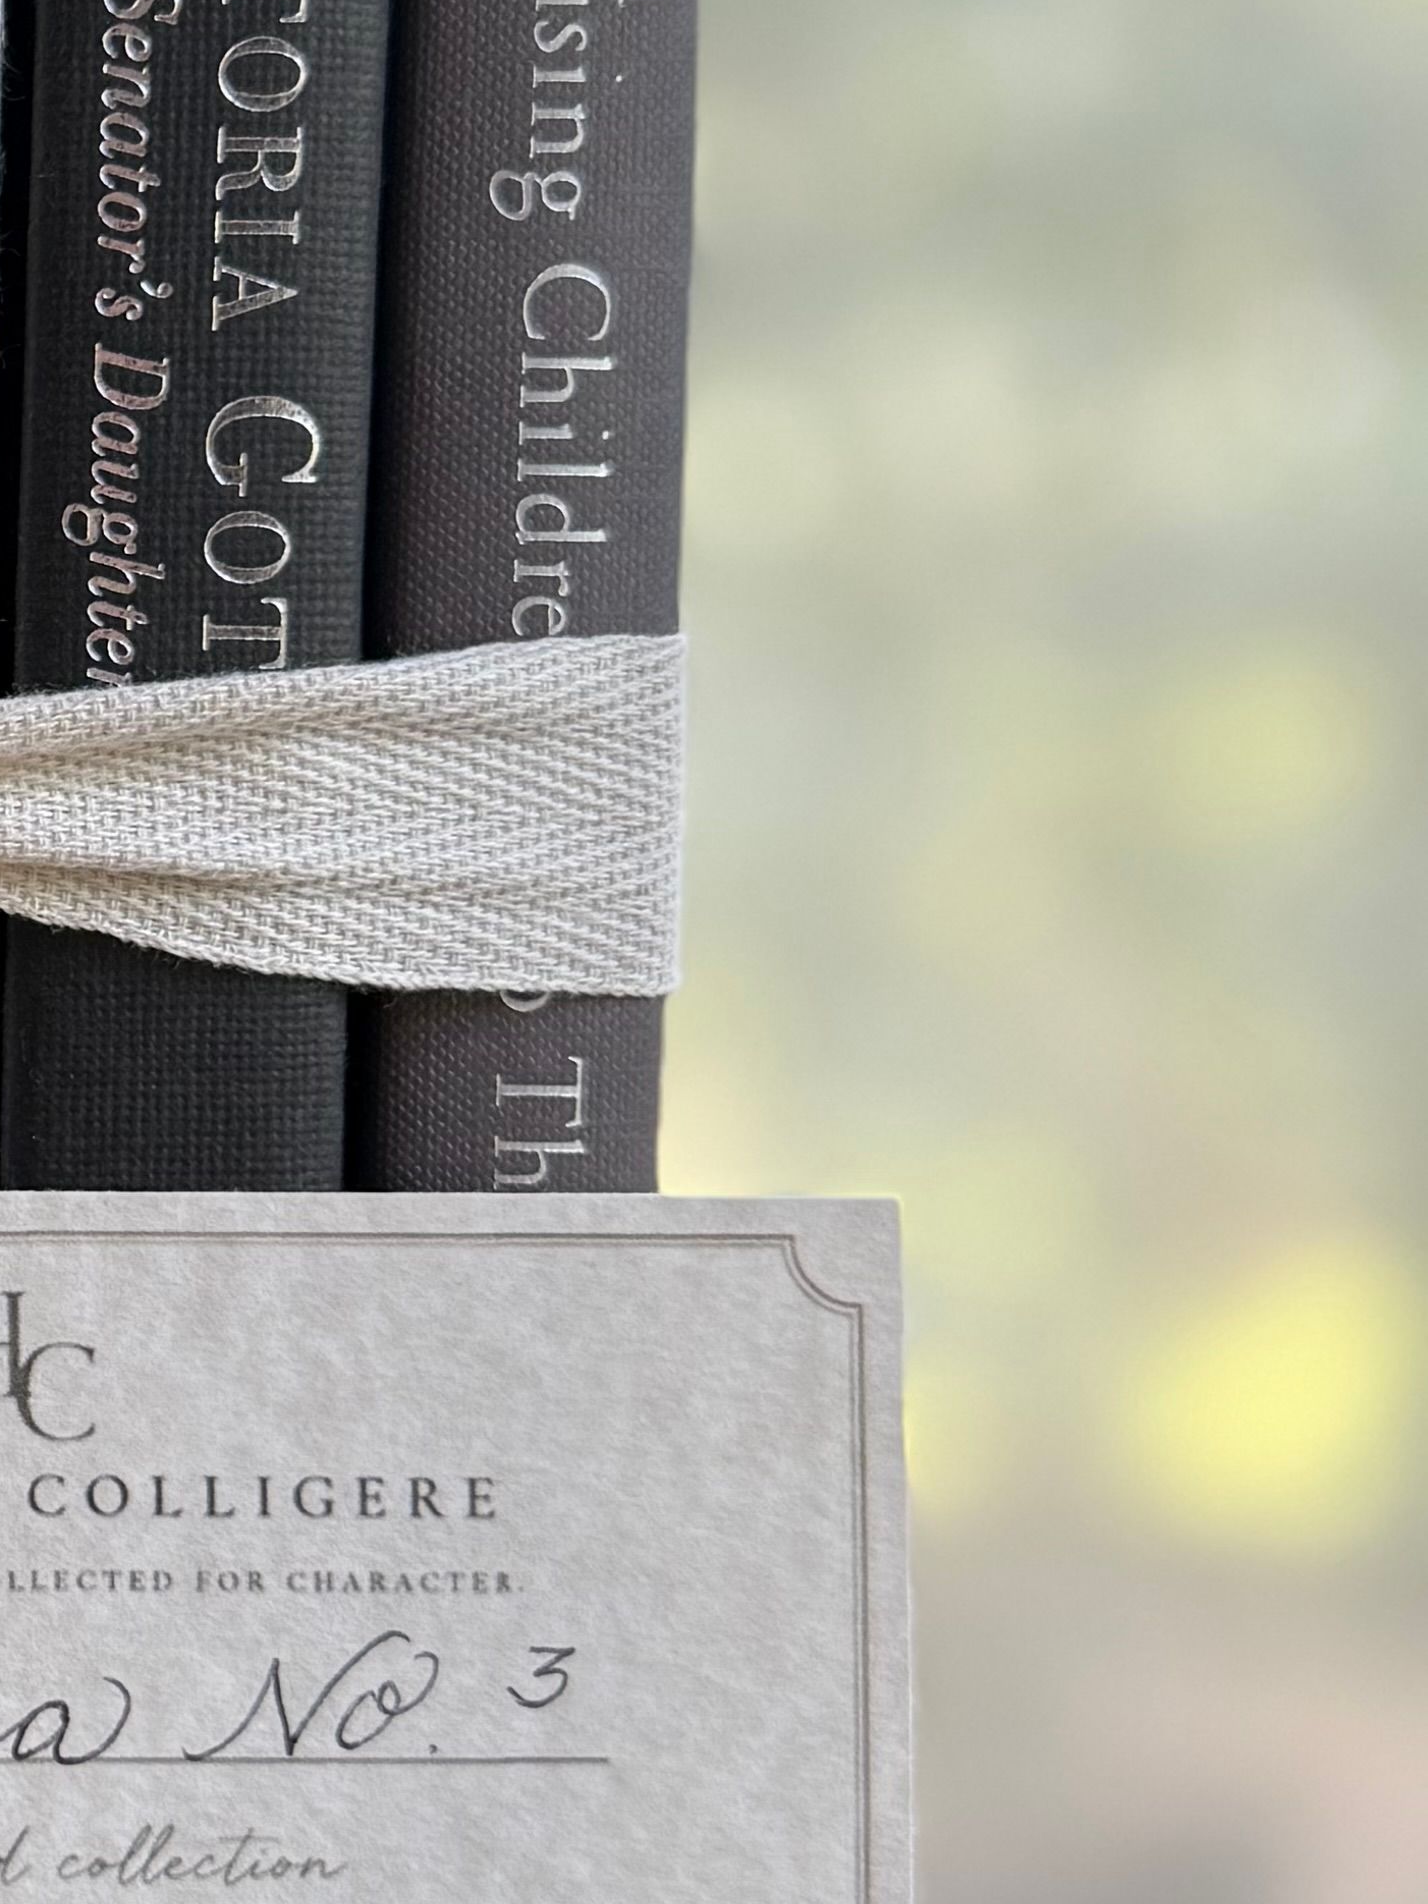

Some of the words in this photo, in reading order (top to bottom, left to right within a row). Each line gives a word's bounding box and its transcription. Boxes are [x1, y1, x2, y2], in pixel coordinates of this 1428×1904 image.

[511, 261, 611, 637] Childre
[203, 394, 322, 670] GOT
[27, 1473, 496, 1521] COLLIGERE
[194, 1567, 266, 1594] FOR
[285, 1569, 524, 1596] CHARACTER.
[506, 1645, 577, 1711] 3
[55, 1822, 348, 1889] collection
